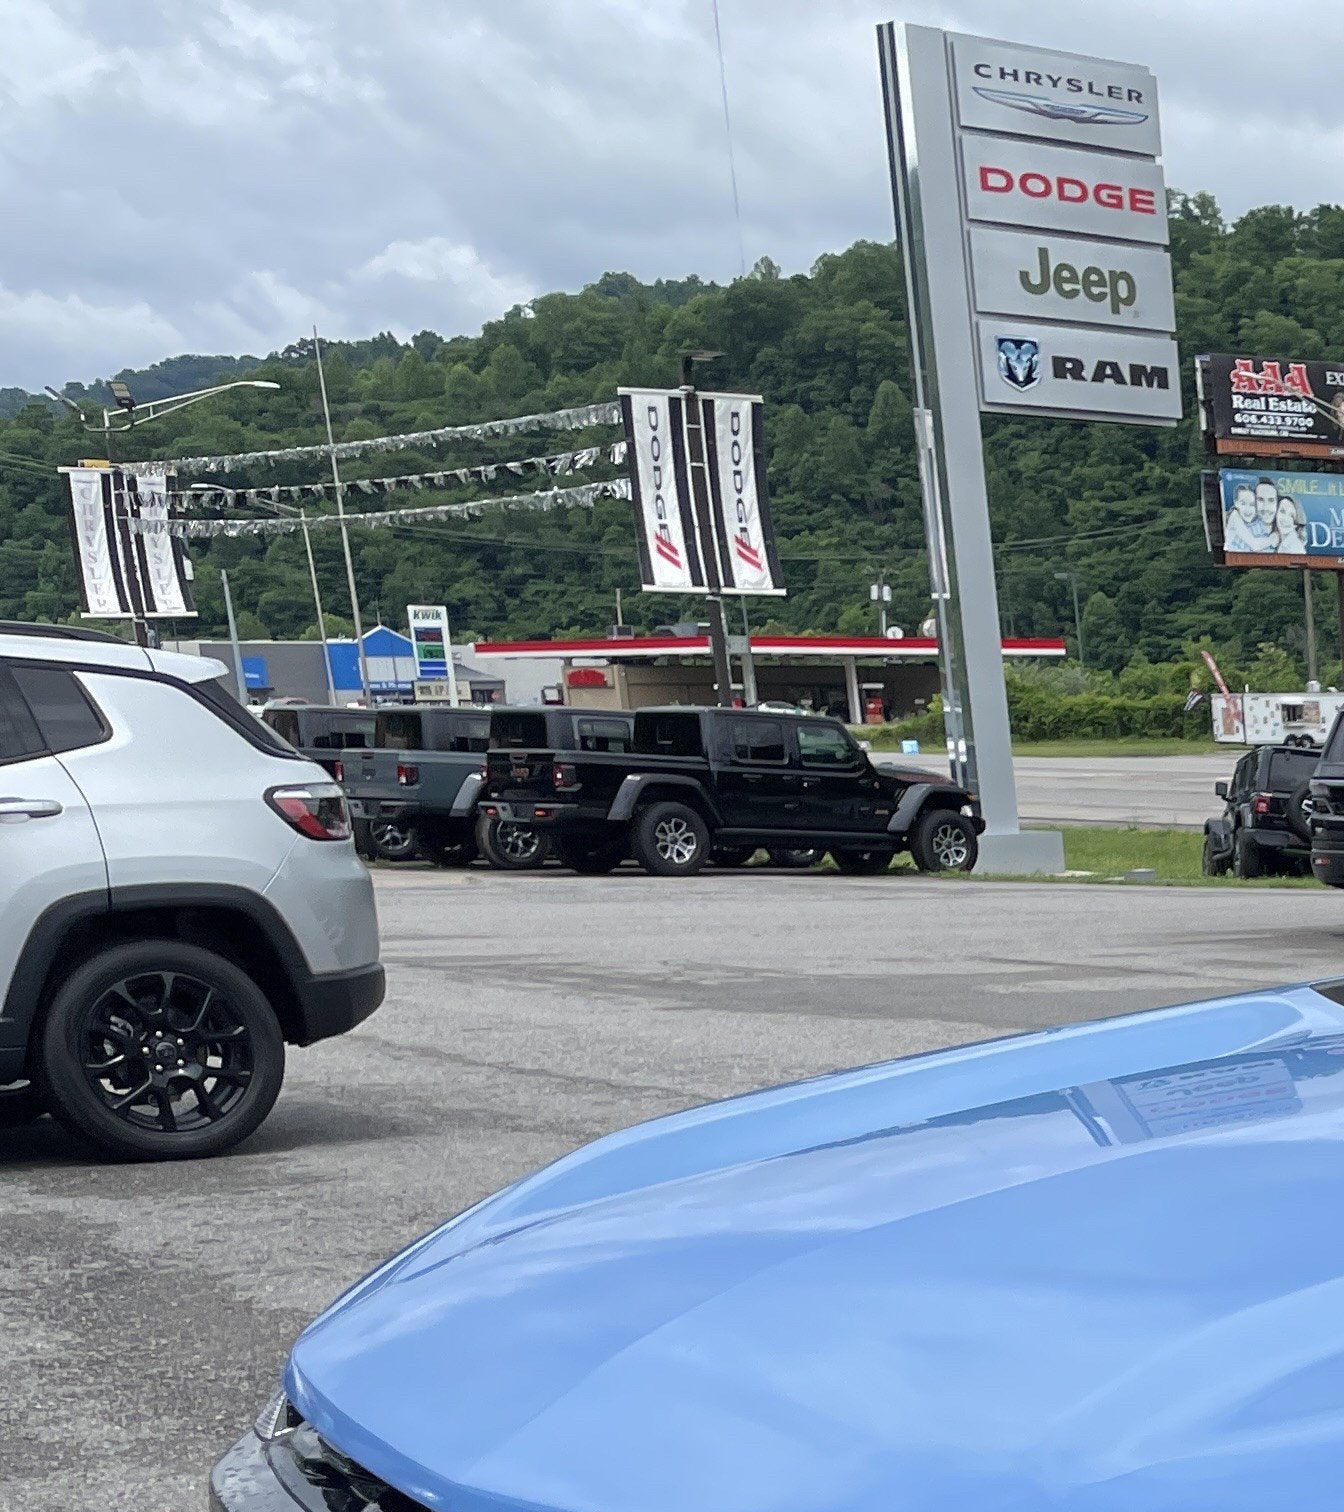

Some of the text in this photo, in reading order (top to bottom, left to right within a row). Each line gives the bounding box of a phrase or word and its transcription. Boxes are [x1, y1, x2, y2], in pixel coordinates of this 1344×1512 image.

[974, 63, 1143, 104] CHRYSLER
[979, 166, 1156, 214] DODGE
[1019, 246, 1136, 315] Jeep
[1051, 355, 1170, 390] RAM
[1230, 359, 1314, 398] AAA
[1231, 394, 1318, 414] Real Estate
[647, 406, 672, 547] DODGE
[730, 412, 751, 547] DODGE
